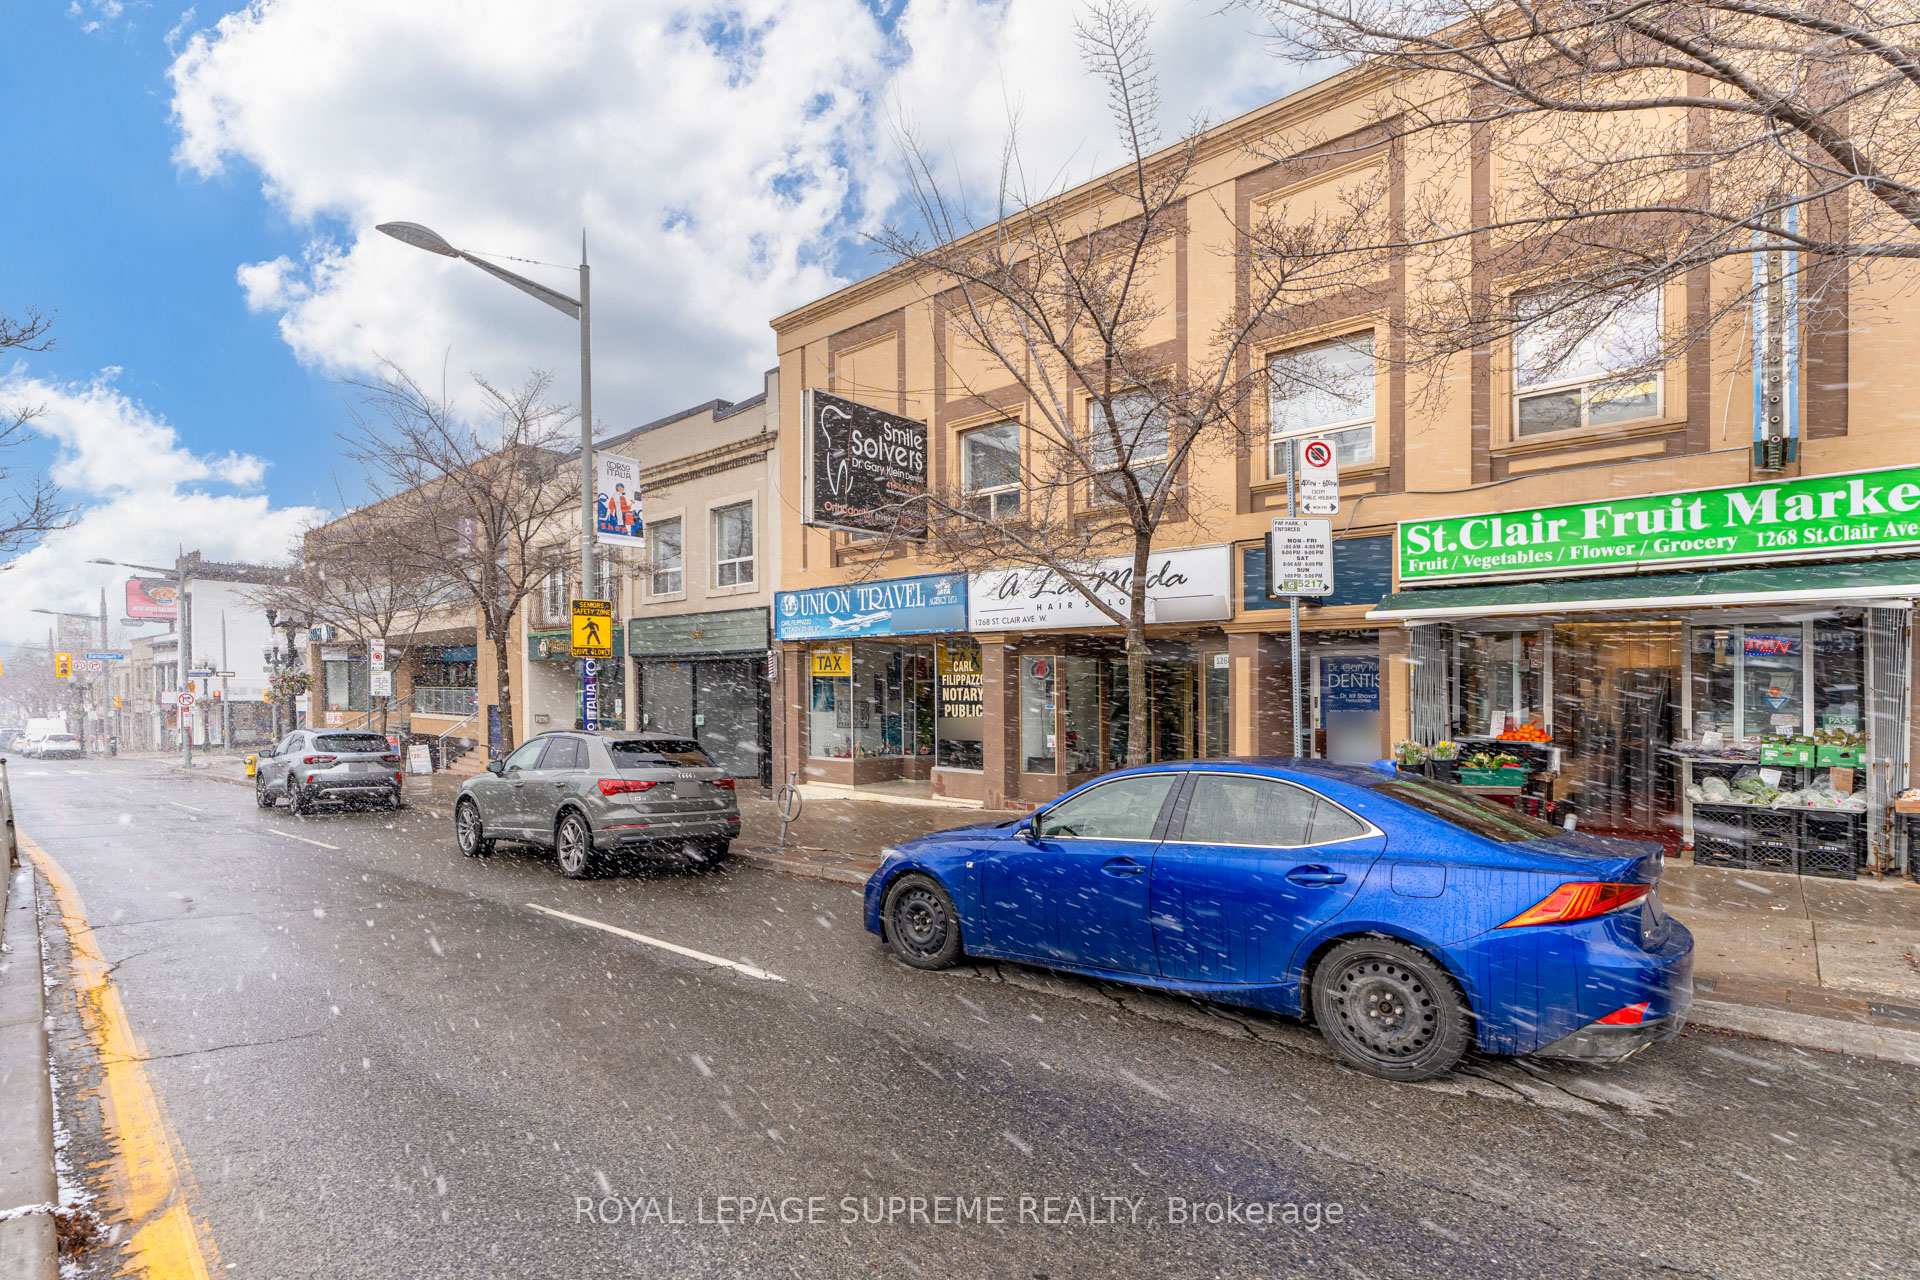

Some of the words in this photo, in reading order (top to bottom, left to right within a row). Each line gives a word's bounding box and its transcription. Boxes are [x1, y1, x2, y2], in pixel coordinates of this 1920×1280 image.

[884, 422, 923, 451] Smile
[851, 429, 923, 471] Solvers
[606, 460, 631, 472] CORSO
[852, 457, 863, 469] Dr.
[864, 461, 885, 476] Gary
[886, 465, 905, 479] Klein
[1406, 511, 1568, 556] St.Clair
[1581, 497, 1710, 540] Fruit
[1757, 530, 1798, 548] 1268
[1803, 524, 1879, 545] St.Clair
[1883, 521, 1919, 538] Ave
[1408, 556, 1449, 572] Fruit
[1451, 555, 1459, 570] /
[1463, 549, 1553, 570] Vegetables
[1556, 546, 1566, 562] /
[1570, 541, 1636, 560] Flower
[1640, 539, 1648, 556] /
[1653, 535, 1738, 553] Grocery
[1092, 560, 1188, 592] Mda
[1298, 579, 1323, 588] 5217
[578, 601, 604, 609] SENIORS
[801, 590, 851, 616] UNION
[857, 582, 926, 611] TRAVEL
[1036, 601, 1073, 611] HAIR
[975, 618, 991, 626] 1268
[1001, 616, 1022, 625] CLAIR
[816, 655, 842, 671] TAX
[953, 660, 974, 672] CARL
[586, 683, 598, 720] ITALIA
[942, 687, 983, 701] NOTARY
[944, 703, 983, 718] PUBLIC
[1828, 716, 1853, 725] PASS
